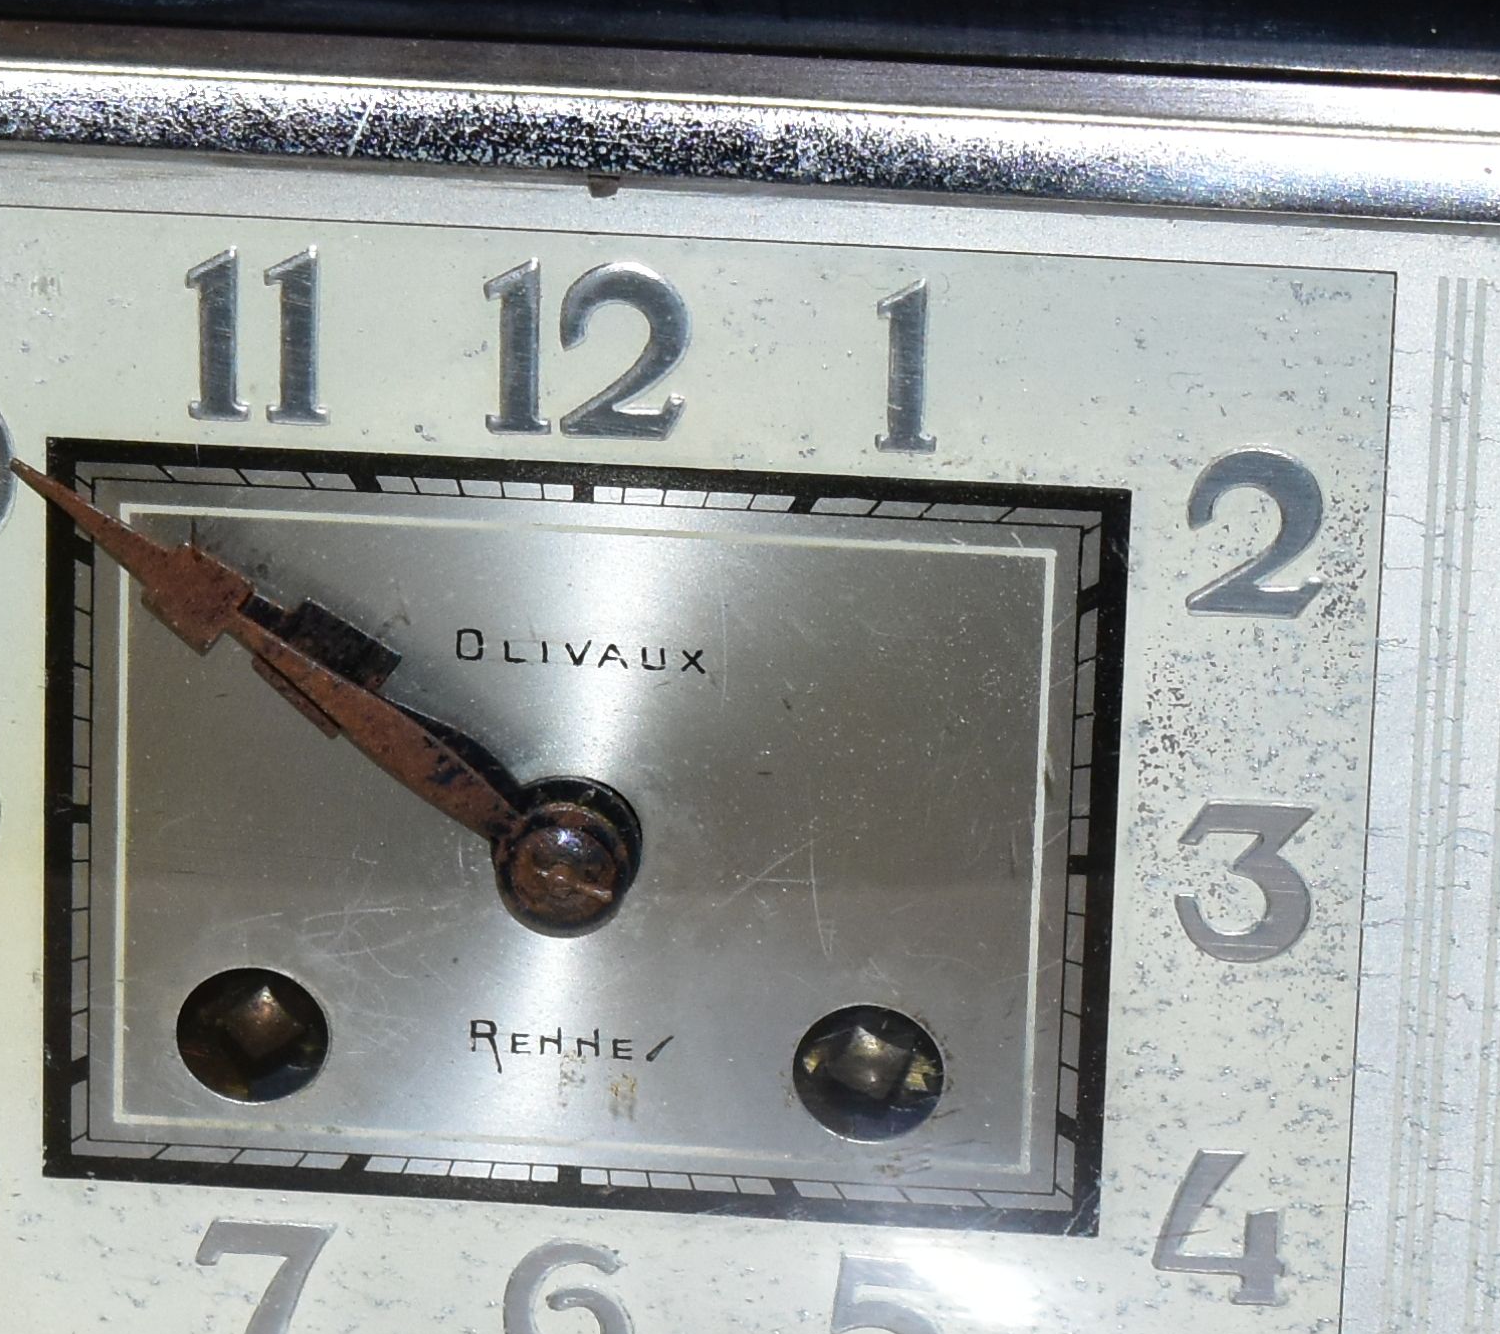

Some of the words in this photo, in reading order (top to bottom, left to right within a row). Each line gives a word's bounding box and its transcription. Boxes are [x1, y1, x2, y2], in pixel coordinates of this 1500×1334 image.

[185, 244, 330, 425] 11
[484, 257, 692, 441] 12
[874, 278, 937, 454] 1
[1187, 443, 1324, 620] 2
[455, 627, 706, 675] OLIVAUX
[1173, 799, 1314, 963] 3
[1151, 1149, 1288, 1307] 4
